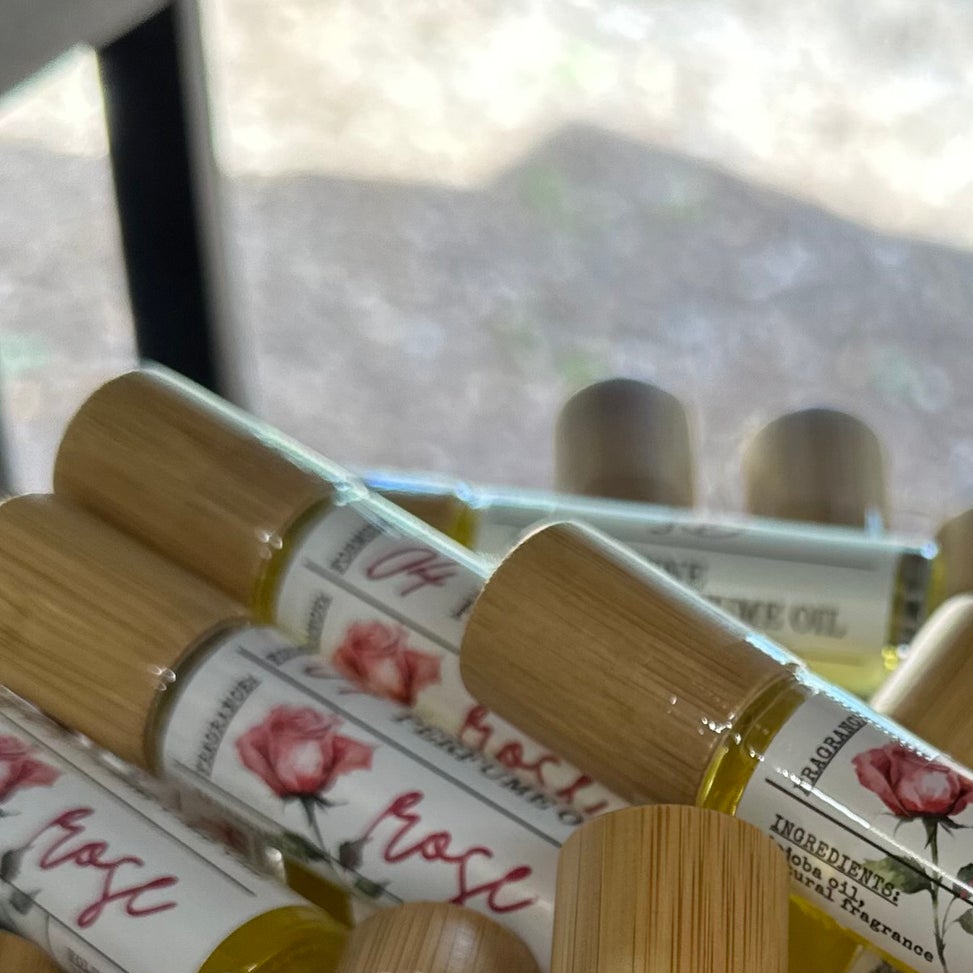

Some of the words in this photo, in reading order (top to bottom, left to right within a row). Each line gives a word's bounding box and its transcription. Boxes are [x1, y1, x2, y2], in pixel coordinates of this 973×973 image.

[769, 813, 901, 907] INGREDIENTS:
[828, 876, 866, 909] oil,
[840, 898, 935, 964] fragrance
